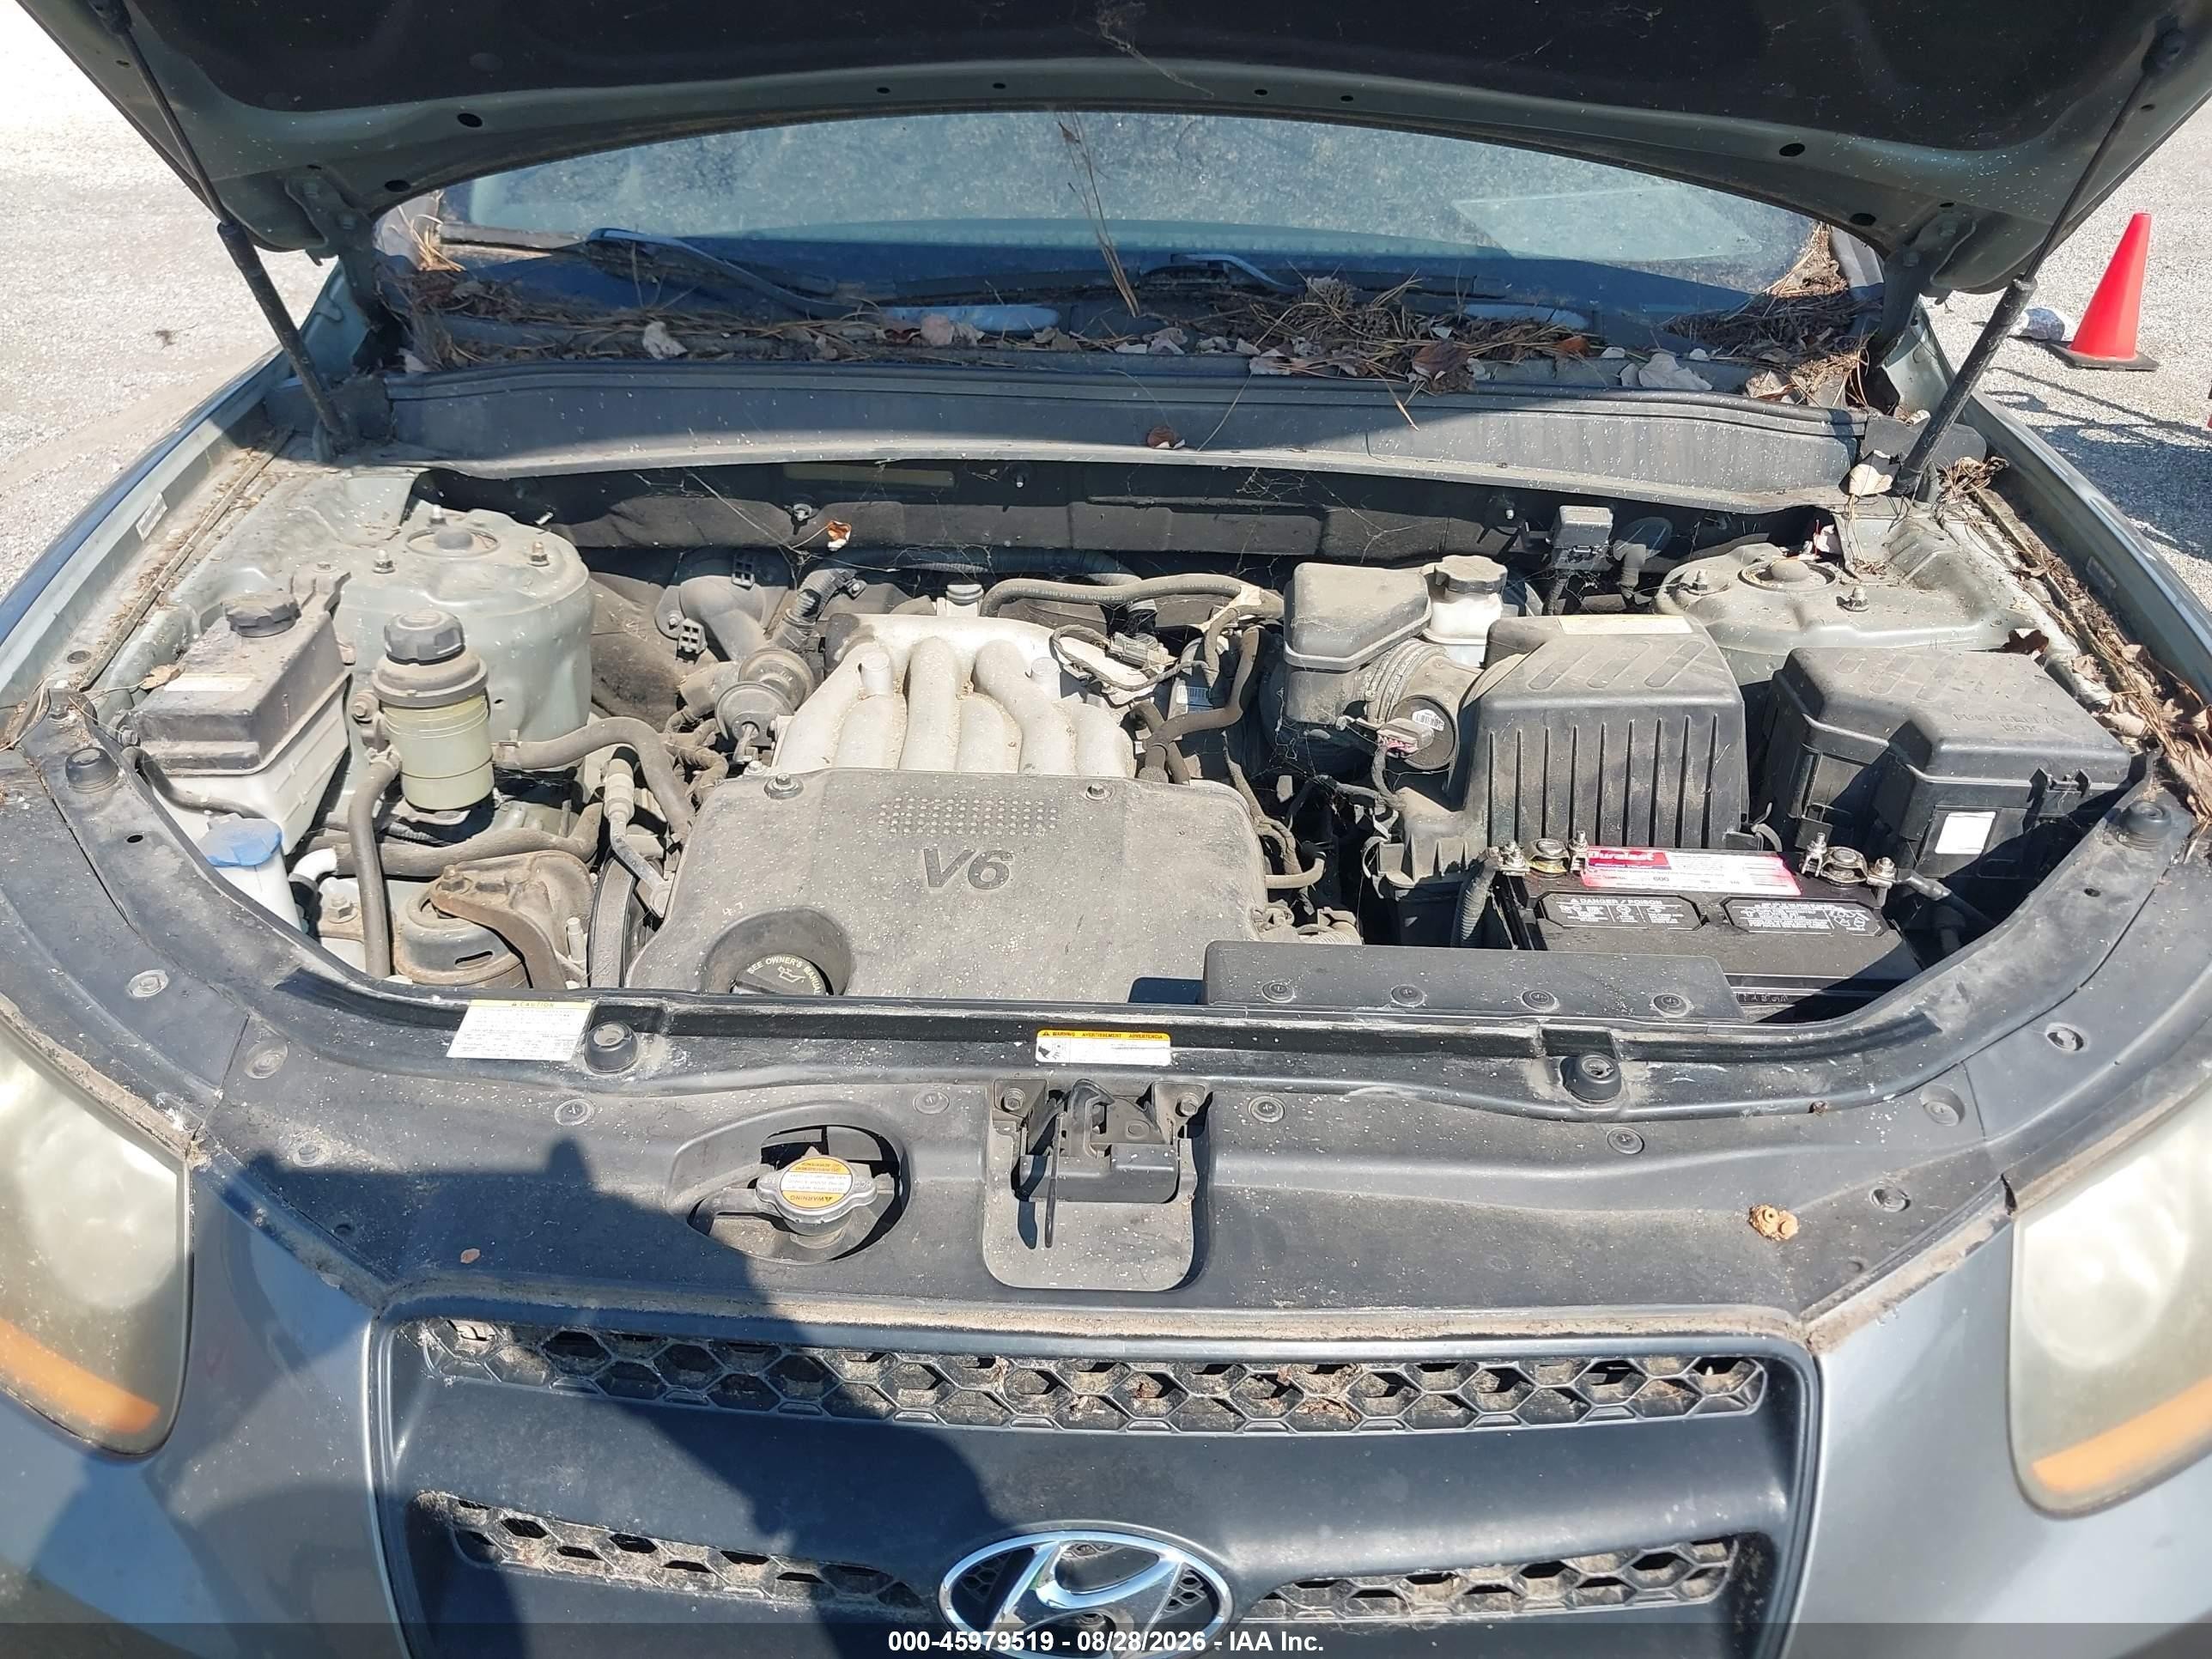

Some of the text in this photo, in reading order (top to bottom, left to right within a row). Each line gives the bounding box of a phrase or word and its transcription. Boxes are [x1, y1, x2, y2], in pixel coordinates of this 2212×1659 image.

[923, 848, 1013, 890] V6
[1587, 850, 1654, 861] Duralast
[746, 956, 822, 995] SEE OWNER'S MANUAL
